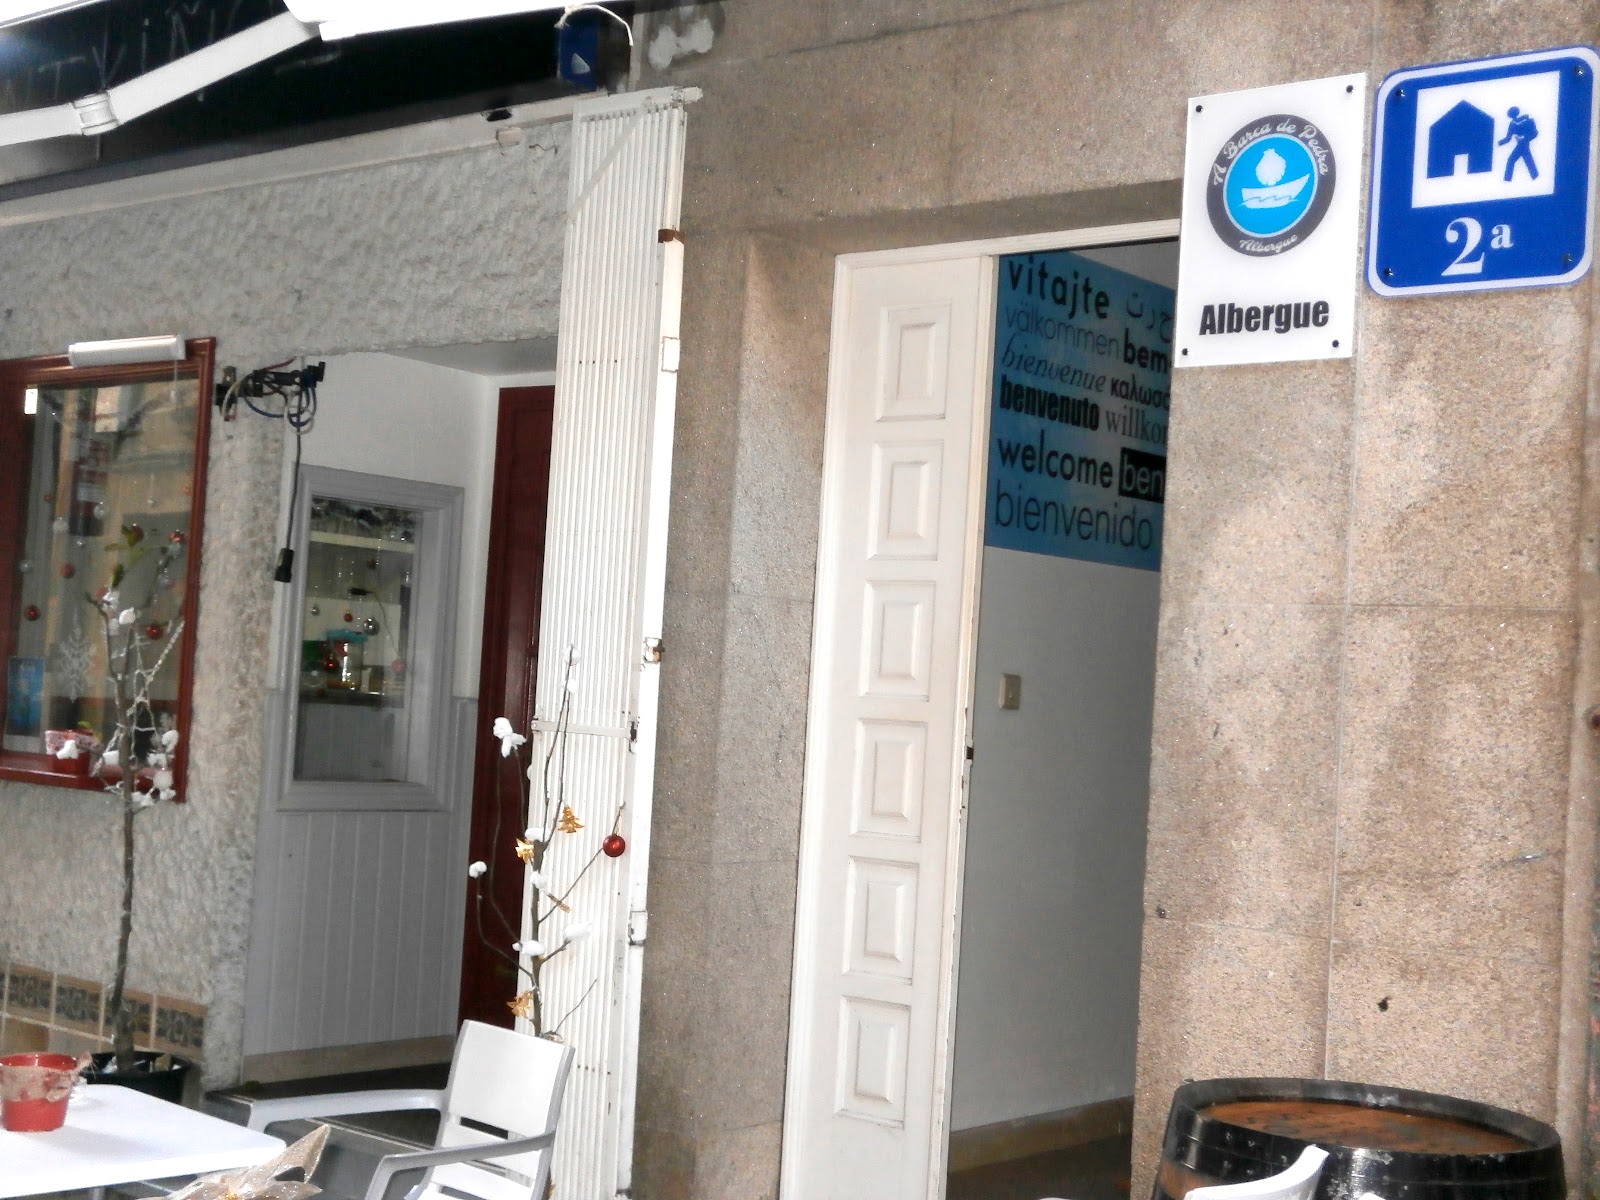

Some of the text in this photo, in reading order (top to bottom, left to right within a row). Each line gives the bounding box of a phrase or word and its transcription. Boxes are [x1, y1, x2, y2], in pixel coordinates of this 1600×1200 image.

[1212, 118, 1329, 186] A Barca de Pedra
[1239, 234, 1298, 253] Albergue
[1008, 255, 1109, 319] vitajte
[1199, 300, 1330, 335] Albergue
[1002, 332, 1106, 393] bienvenue
[1005, 301, 1171, 374] välkommen bem
[999, 374, 1099, 431] benvenuto
[998, 429, 1113, 488] welcome
[995, 480, 1152, 550] bienvenido
